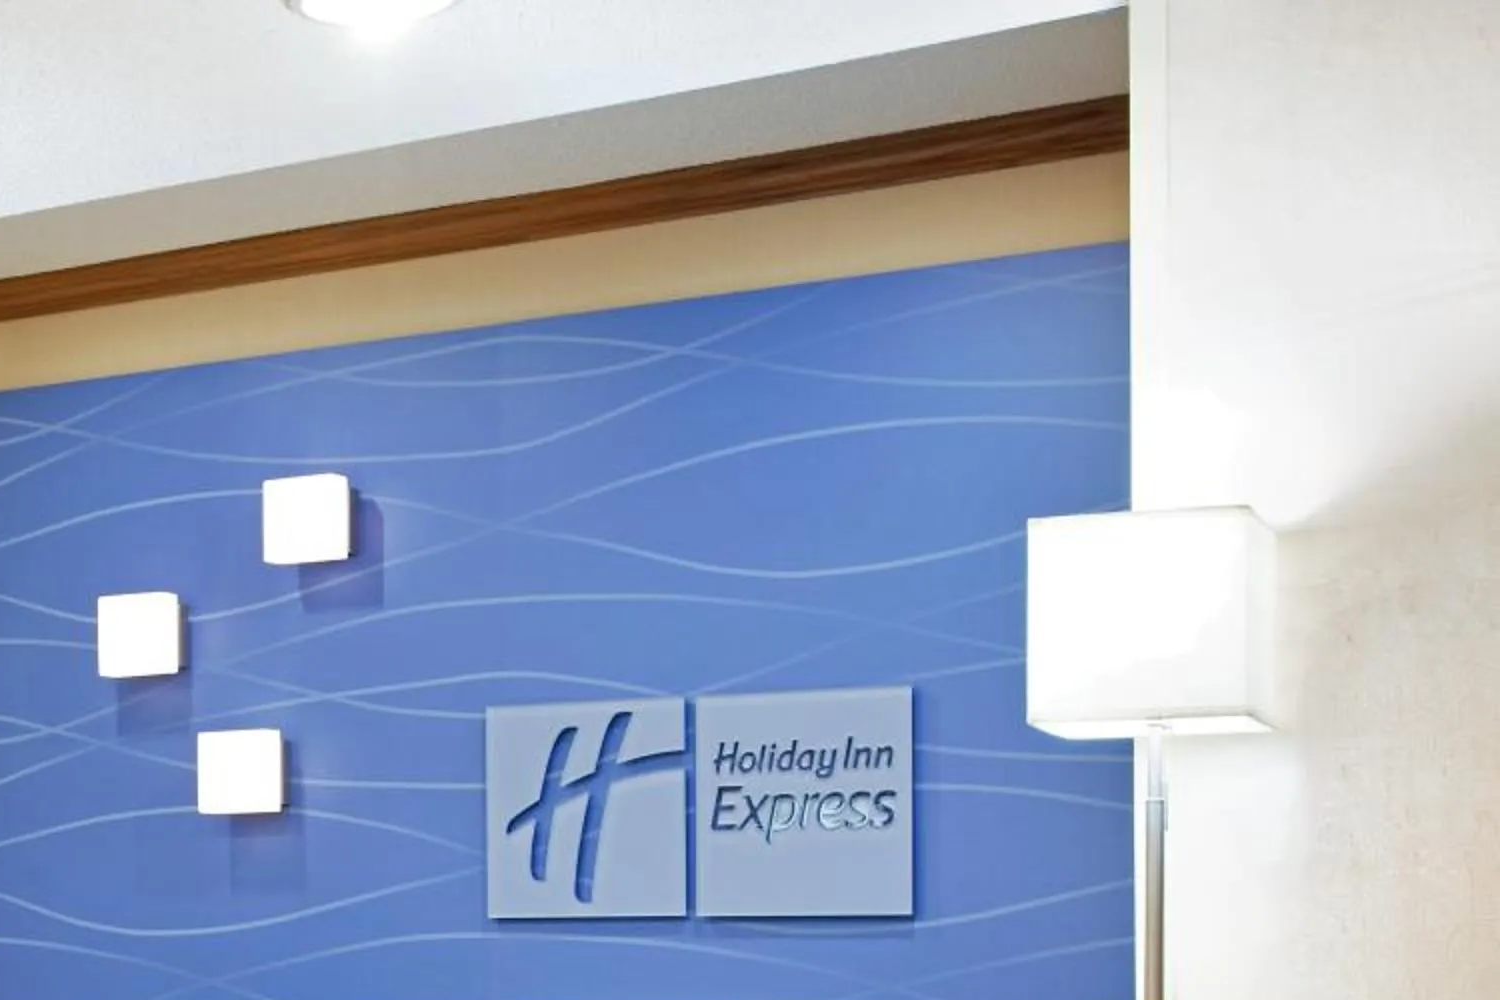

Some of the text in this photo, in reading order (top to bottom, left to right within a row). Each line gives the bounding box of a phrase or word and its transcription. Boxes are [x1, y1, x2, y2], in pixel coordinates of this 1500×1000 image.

[713, 736, 894, 778] Holiday Inn
[711, 785, 897, 844] Express
